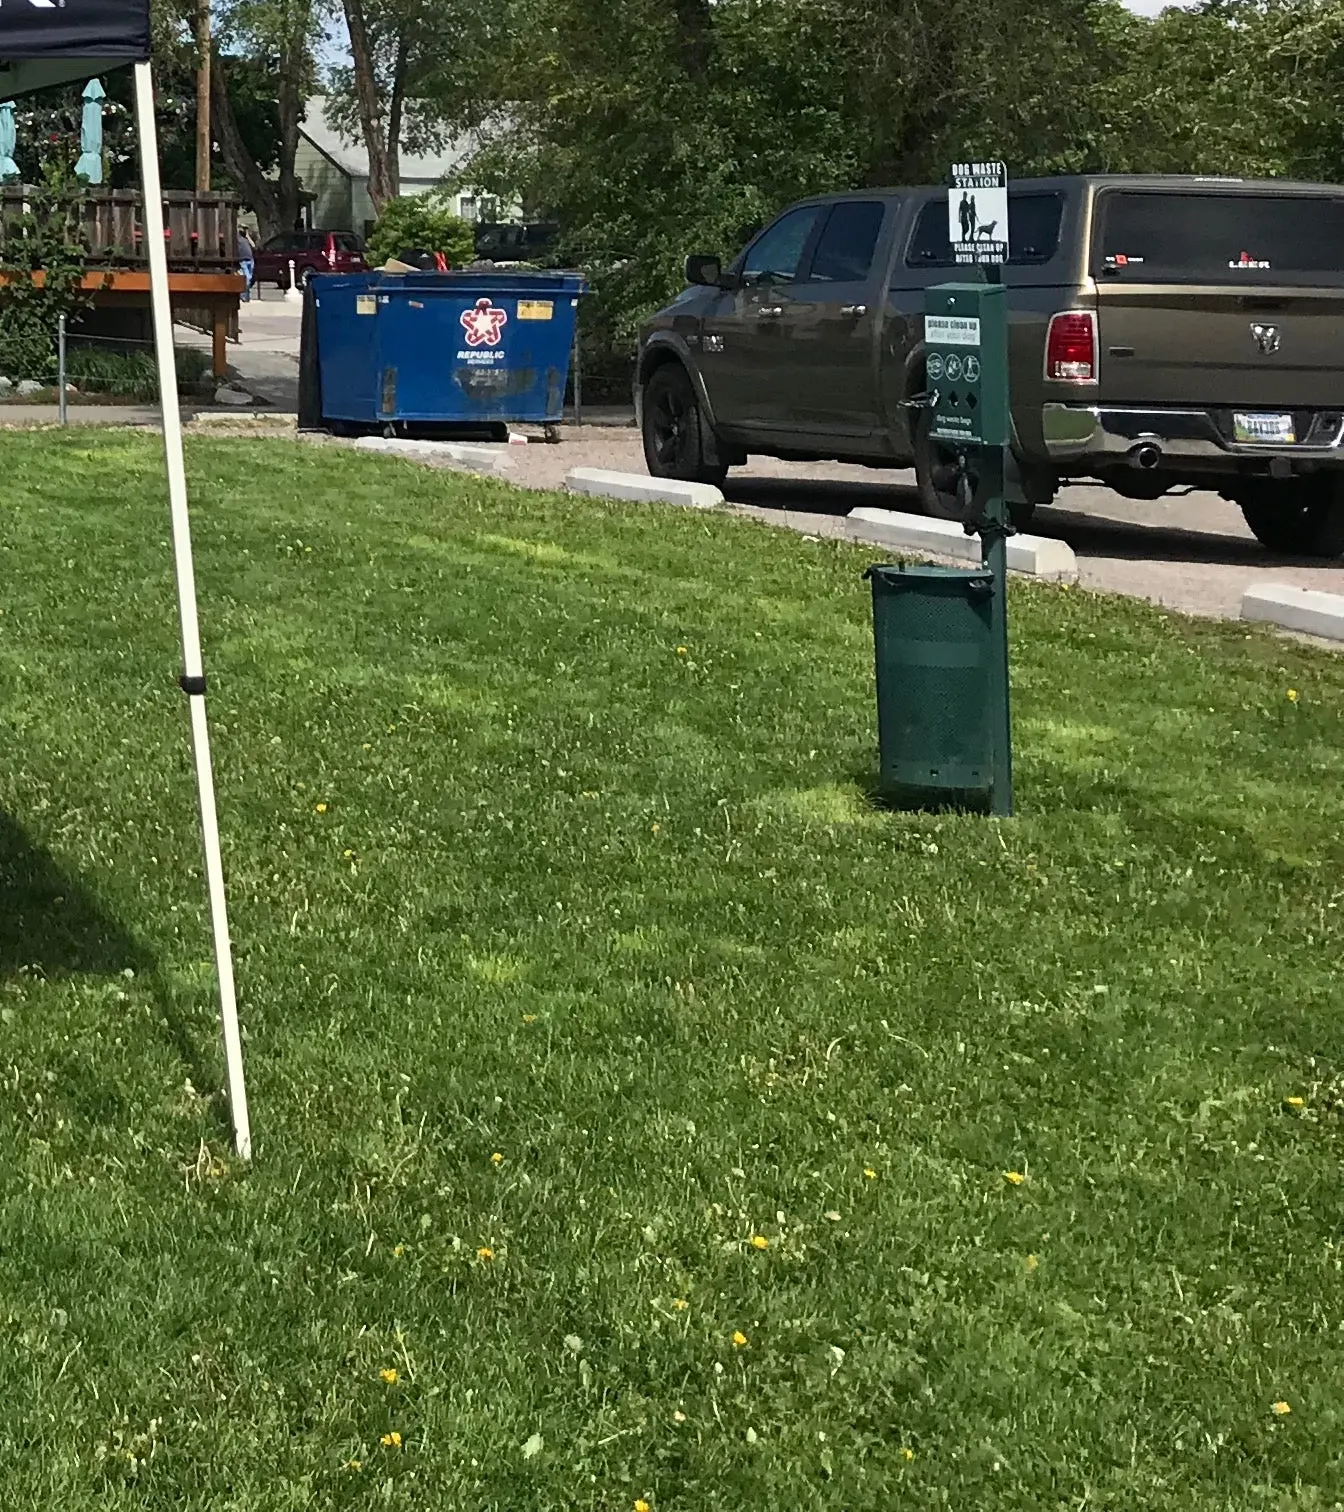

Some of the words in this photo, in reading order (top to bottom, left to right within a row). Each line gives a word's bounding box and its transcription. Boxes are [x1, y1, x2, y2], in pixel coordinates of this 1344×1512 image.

[952, 163, 970, 176] DOG
[972, 162, 1002, 176] WASTE
[955, 176, 999, 188] STATION
[1228, 260, 1271, 269] LEER
[456, 350, 506, 359] REPUBLIC
